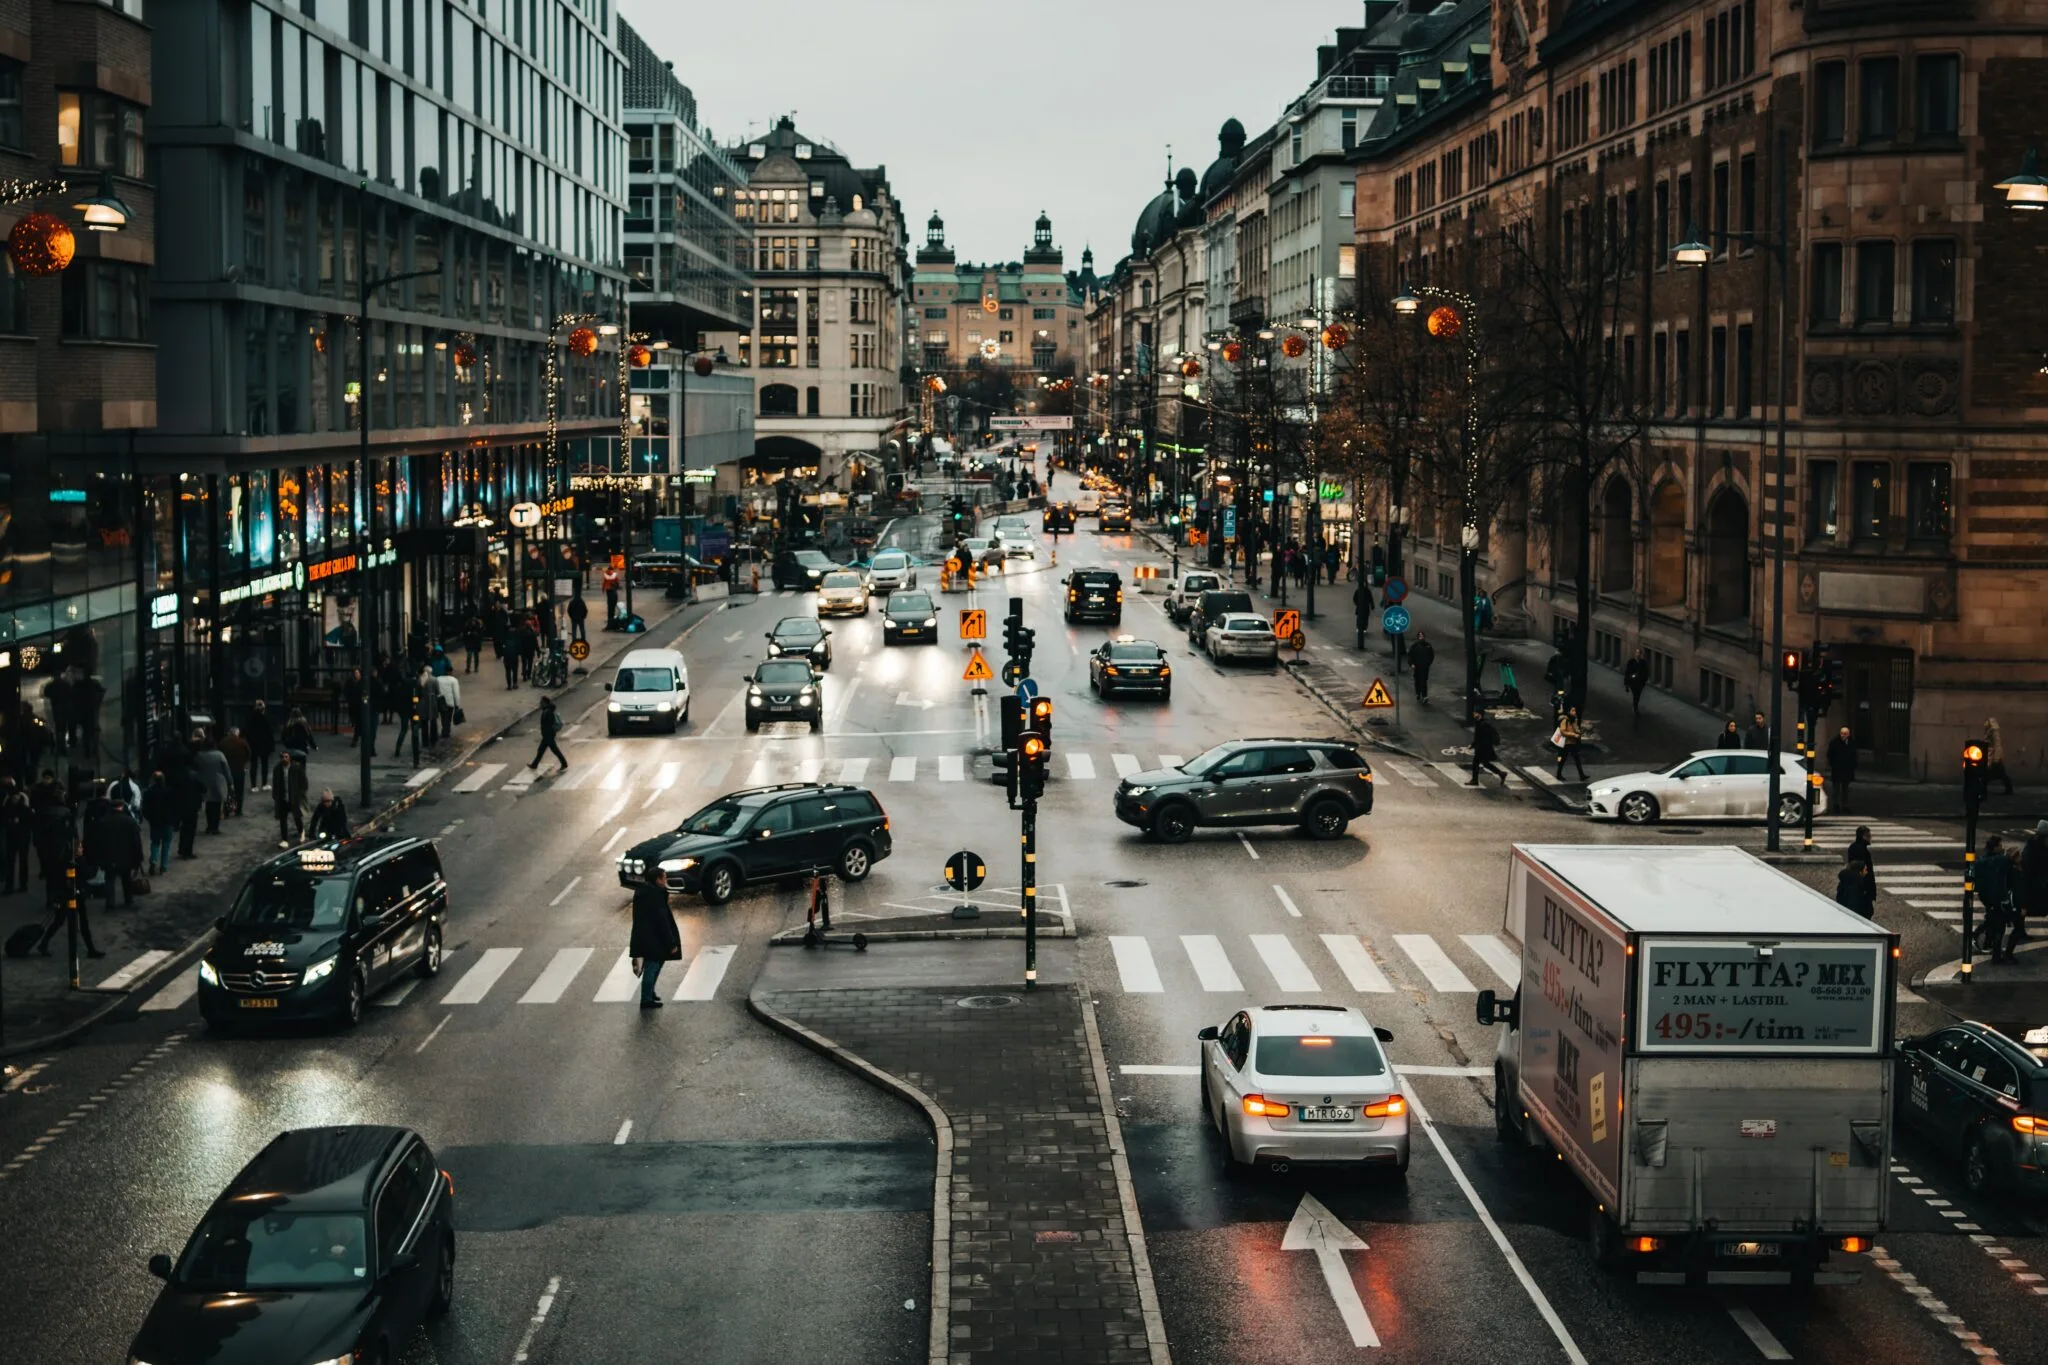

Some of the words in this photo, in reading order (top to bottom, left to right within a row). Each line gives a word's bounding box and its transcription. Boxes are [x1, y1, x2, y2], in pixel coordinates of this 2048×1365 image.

[514, 509, 529, 522] T
[571, 645, 587, 656] 30
[1543, 895, 1604, 988] FLYTTA?
[1654, 961, 1810, 988] FLYTTA?
[1817, 963, 1866, 986] MEX
[1543, 957, 1593, 1039] 495:-/tim
[1811, 986, 1842, 996] 08-668
[1845, 987, 1857, 996] 33
[1859, 987, 1872, 996] 00
[1673, 995, 1680, 1006] 2
[1684, 995, 1717, 1006] MAN
[1720, 996, 1728, 1004] +
[1732, 995, 1789, 1006] LASTBIL
[1654, 1013, 1806, 1040] 495:-/tim
[1308, 1109, 1327, 1119] MTR
[1330, 1109, 1350, 1119] 096
